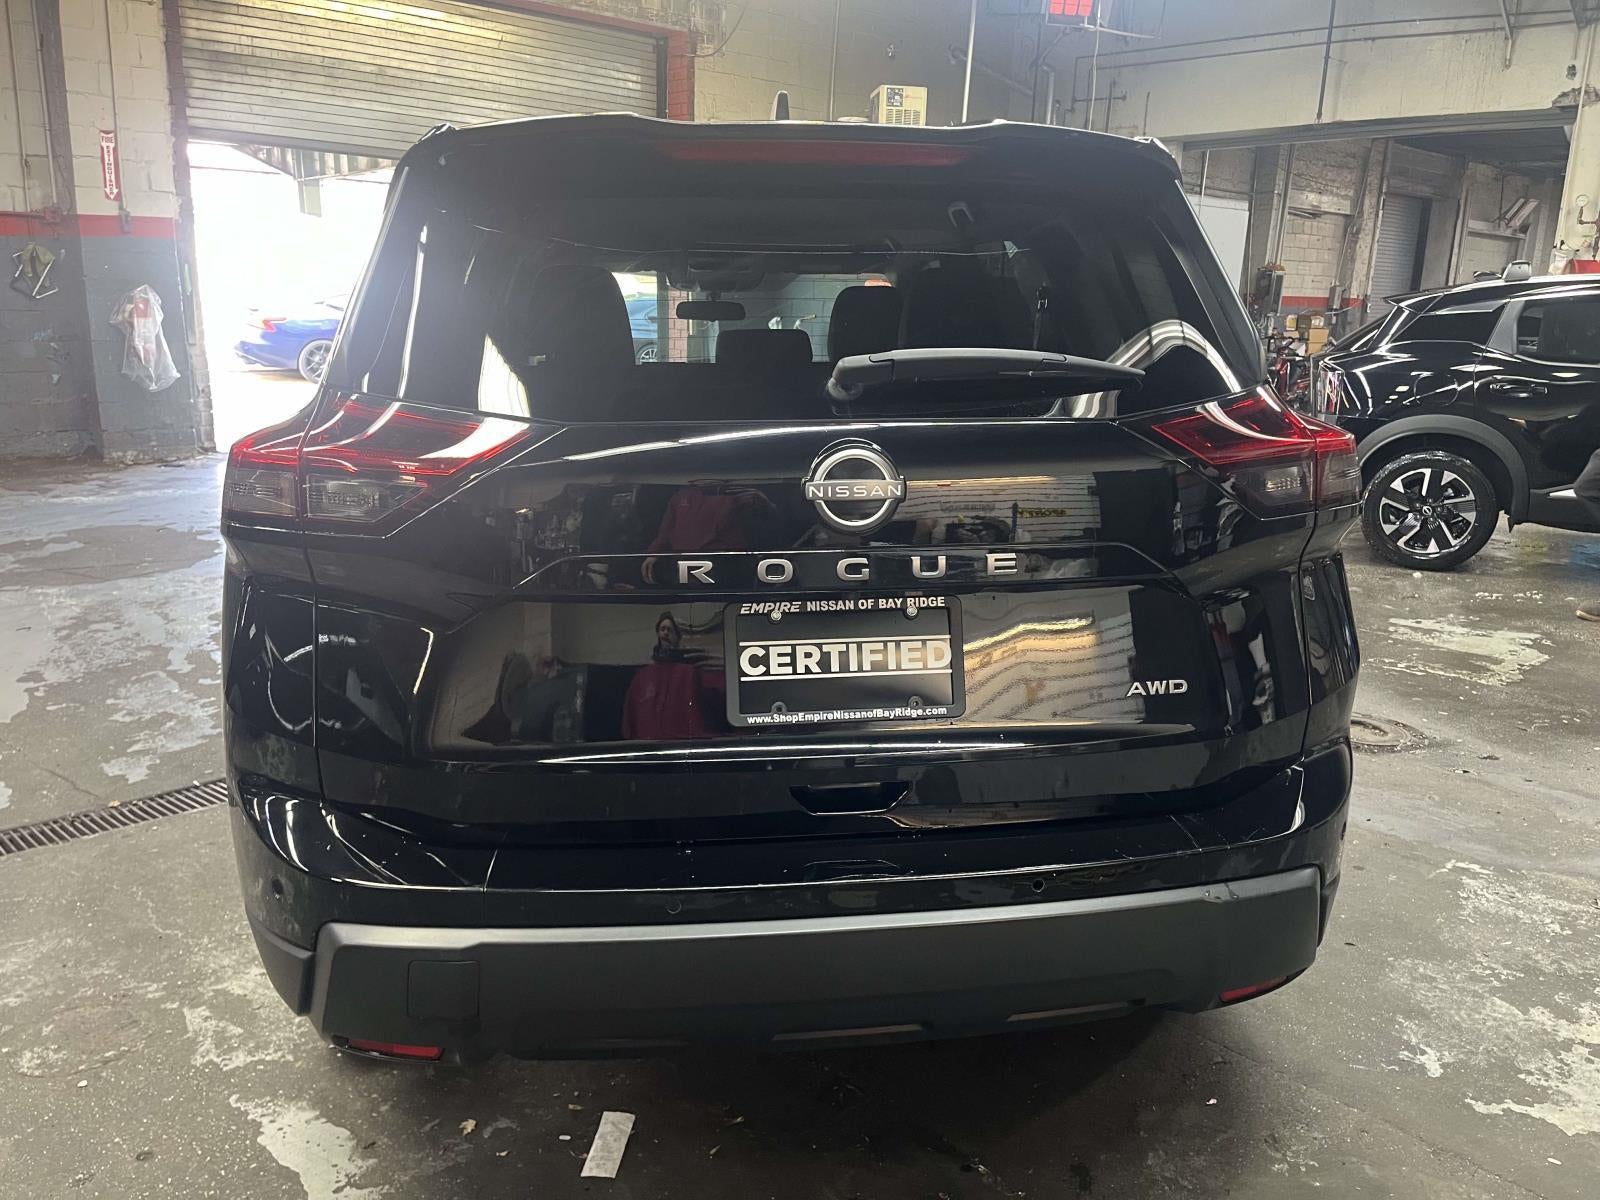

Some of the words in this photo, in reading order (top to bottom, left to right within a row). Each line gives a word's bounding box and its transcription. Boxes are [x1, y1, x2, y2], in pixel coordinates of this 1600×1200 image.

[808, 485, 902, 499] NISSAN
[677, 553, 1018, 584] ROGUE
[740, 601, 802, 614] EMPIRE
[806, 600, 855, 612] NISSAN
[858, 599, 875, 610] OF
[878, 598, 903, 609] BAY
[906, 596, 946, 608] RIDGE
[739, 640, 952, 676] CERTIFIED
[1126, 679, 1188, 697] AWD
[747, 707, 947, 724] www.ShopEmpireNissanofBayRidge.com
